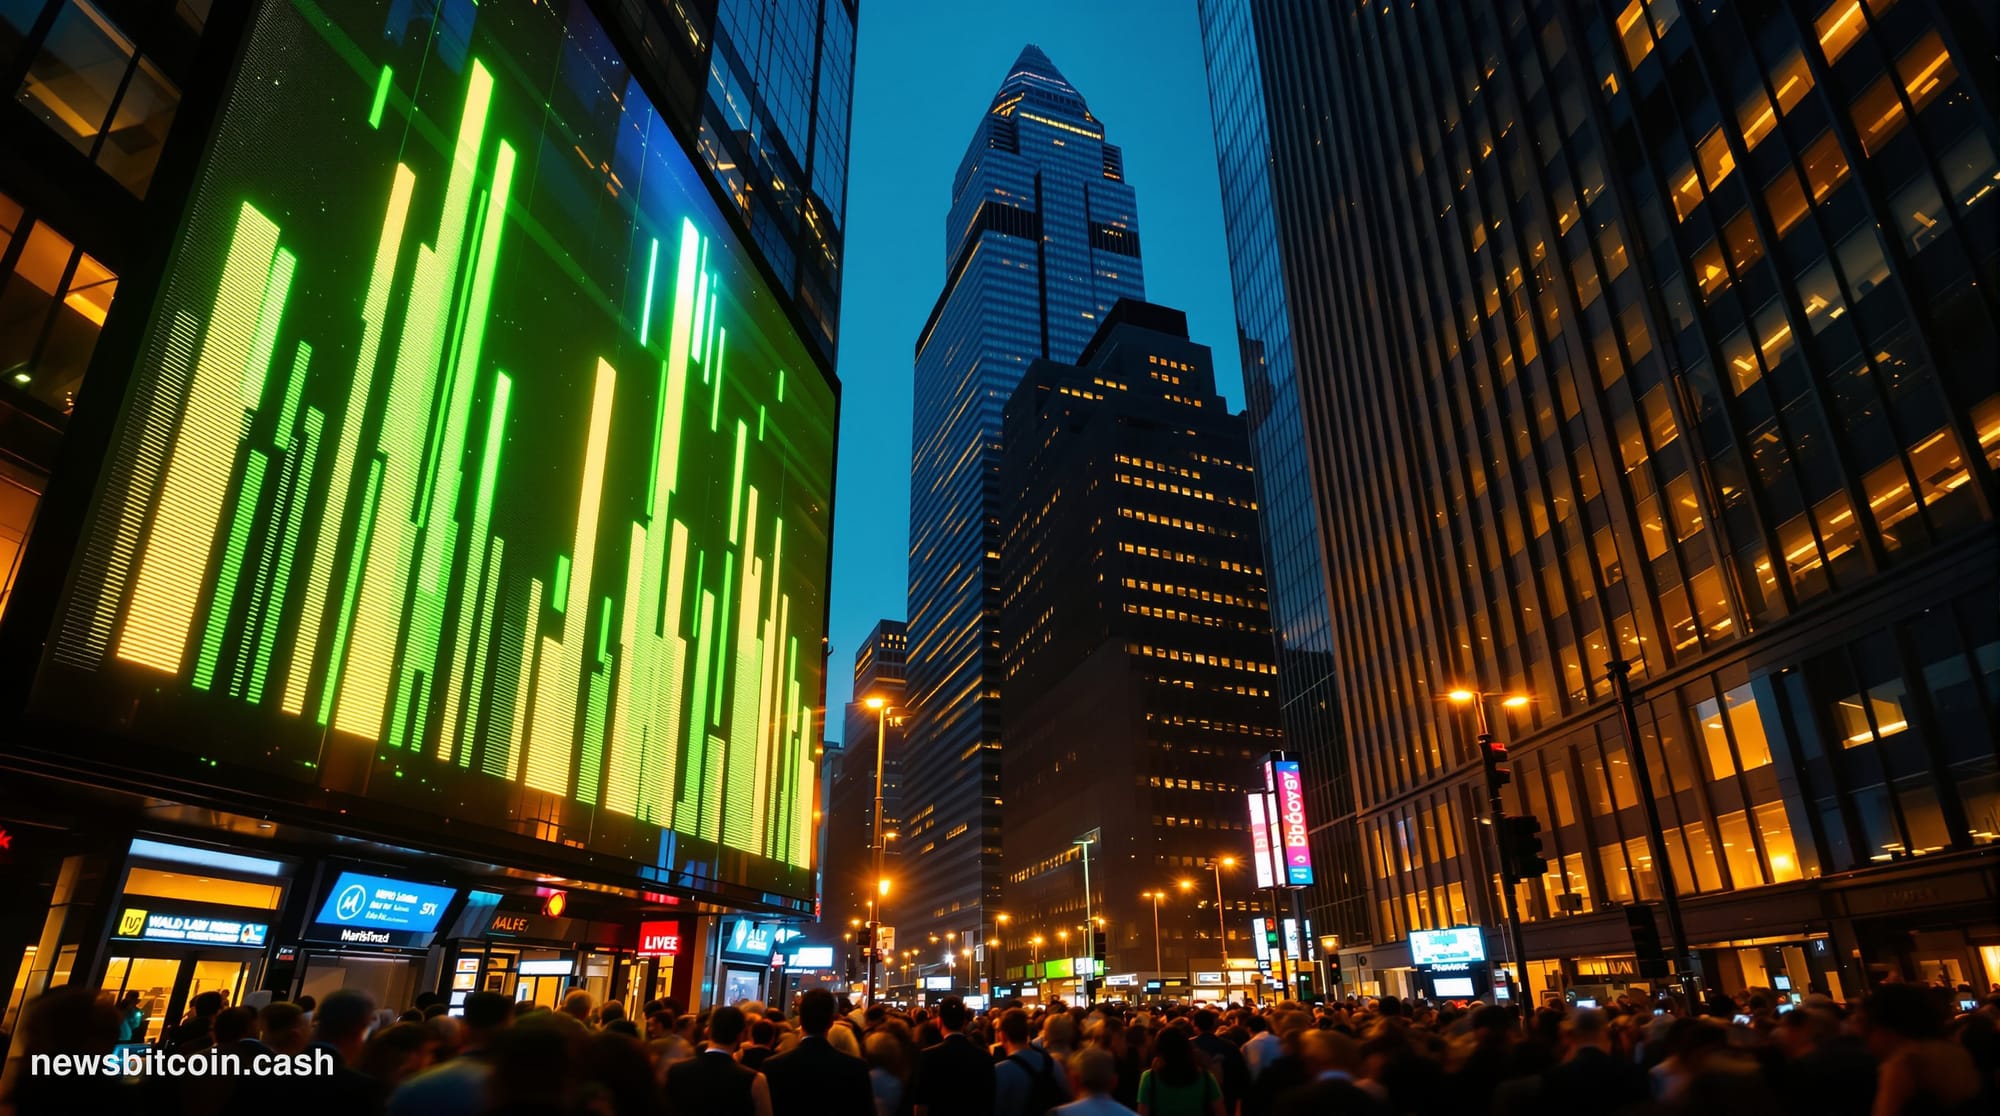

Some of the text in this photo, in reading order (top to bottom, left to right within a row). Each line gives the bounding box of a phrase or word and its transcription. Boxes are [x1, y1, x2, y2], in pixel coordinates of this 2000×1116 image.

[149, 915, 183, 929] WALD
[183, 918, 209, 931] LAW
[644, 935, 678, 950] LIVEE
